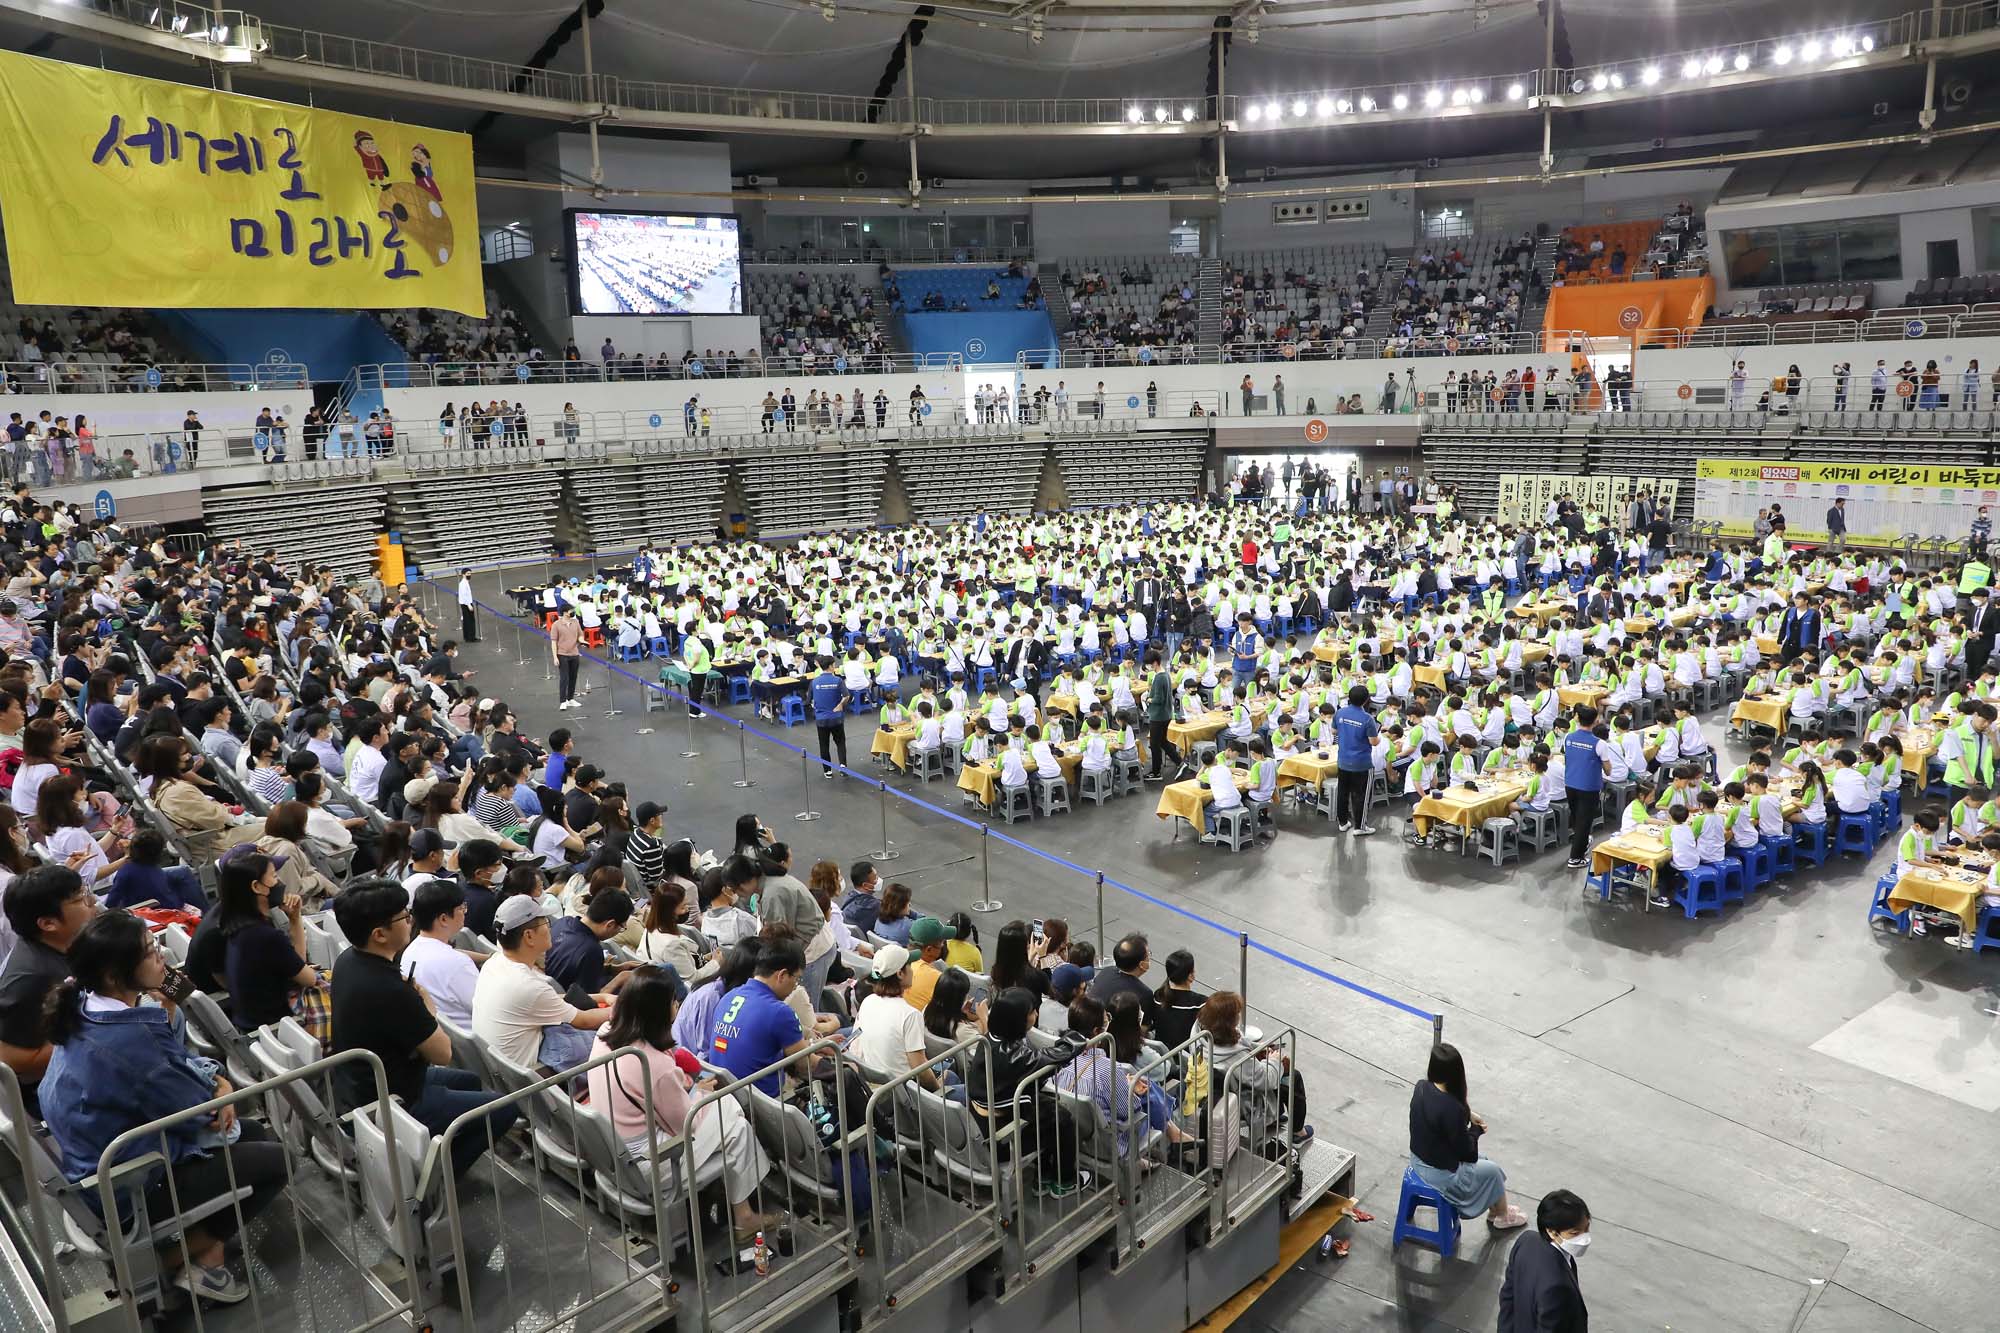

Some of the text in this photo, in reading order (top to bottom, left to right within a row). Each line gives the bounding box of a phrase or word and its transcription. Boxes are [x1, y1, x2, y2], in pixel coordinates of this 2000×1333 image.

[92, 114, 320, 200] 세계로
[229, 209, 423, 280] 미래로
[1624, 312, 1638, 322] S2
[1906, 325, 1924, 333] VVIP
[970, 343, 982, 352] E3
[271, 354, 286, 364] E2
[1310, 424, 1322, 435] S1
[257, 437, 264, 445] 12
[1729, 467, 1759, 477] 제12회
[1761, 466, 1799, 480] 일요신문
[1801, 469, 1811, 480] 배
[1819, 466, 1860, 481] 세계
[1868, 467, 1929, 485] 어린이
[723, 995, 745, 1024] 3
[713, 1021, 741, 1039] SPAIN
